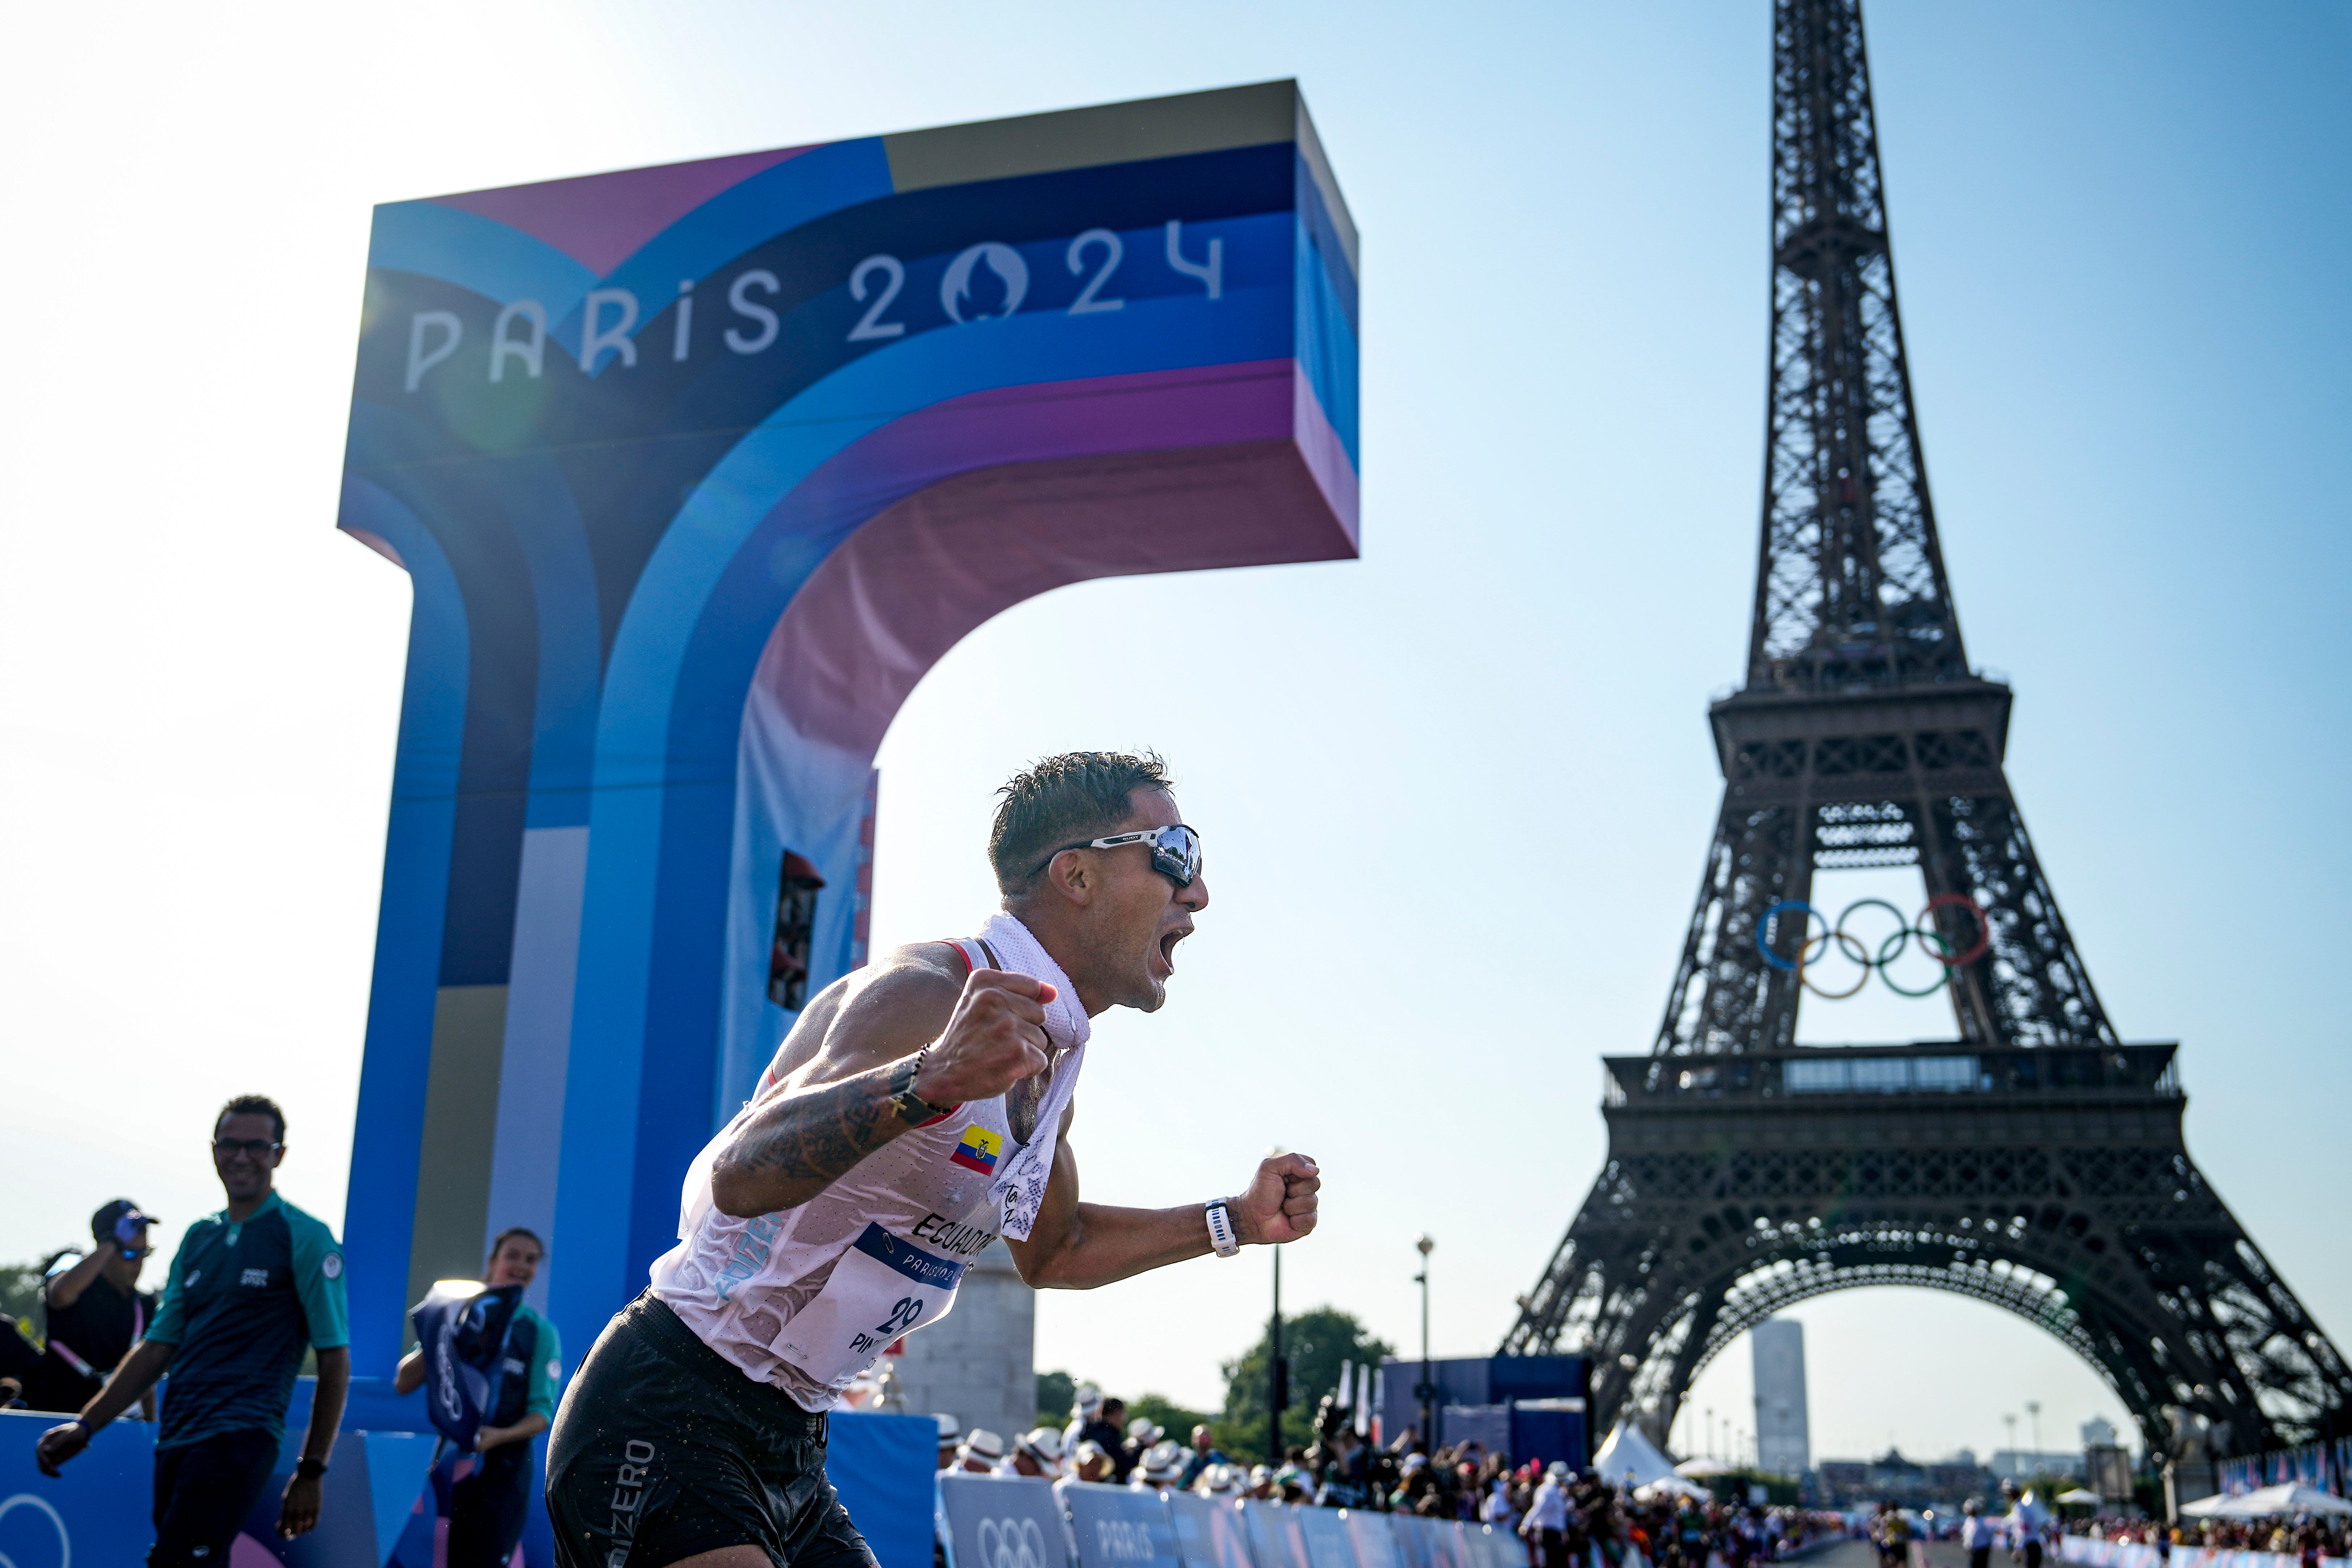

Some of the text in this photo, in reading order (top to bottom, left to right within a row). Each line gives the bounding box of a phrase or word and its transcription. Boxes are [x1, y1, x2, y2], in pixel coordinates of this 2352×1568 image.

[715, 1212, 782, 1301] ADIZE
[911, 1213, 997, 1258] ECUADOR
[875, 1297, 923, 1334] 29
